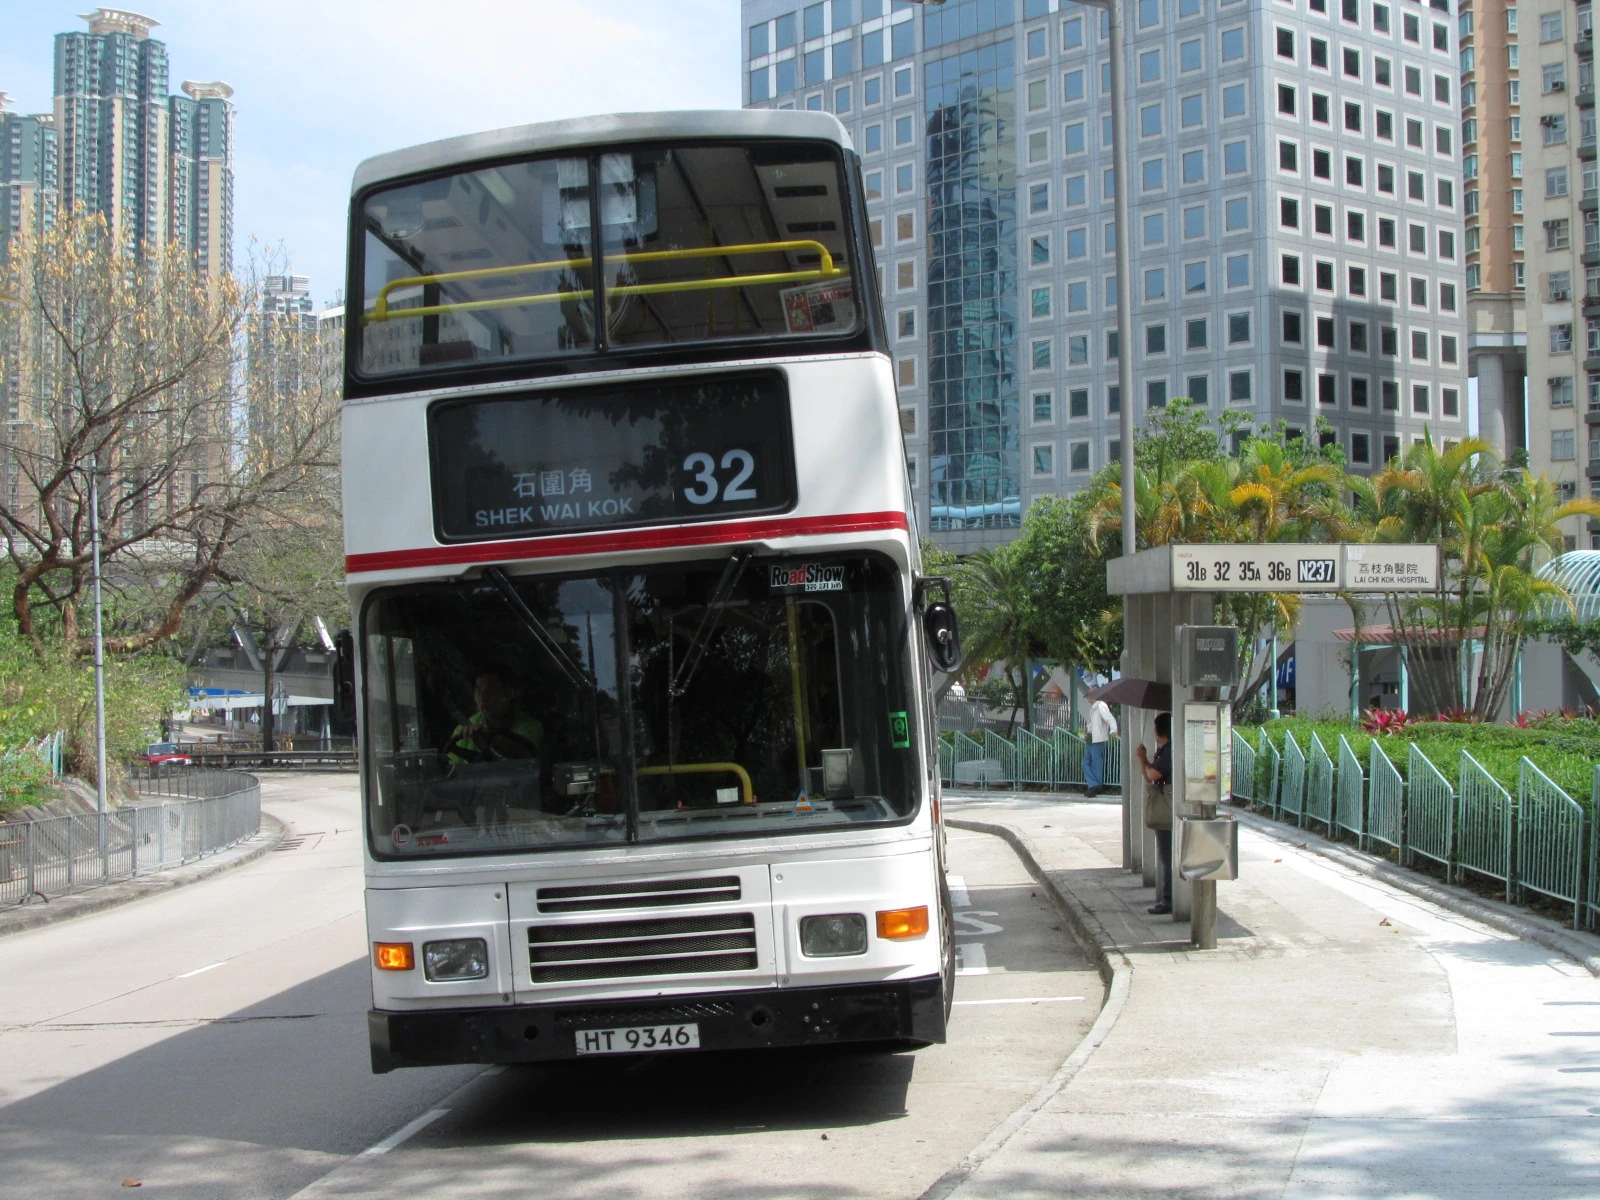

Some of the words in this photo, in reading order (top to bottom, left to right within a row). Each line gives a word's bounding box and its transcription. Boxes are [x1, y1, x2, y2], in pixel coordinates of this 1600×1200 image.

[512, 467, 592, 498] 石圍角
[682, 448, 758, 505] 32
[475, 507, 534, 527] SHEK
[540, 501, 581, 523] WAI
[588, 497, 635, 518] KOK
[771, 563, 844, 587] RoadShow
[1186, 561, 1207, 582] 31B
[1213, 561, 1231, 582] 32
[1238, 561, 1261, 582] 35A
[1267, 561, 1292, 582] 36B
[1299, 560, 1334, 583] N237
[1354, 576, 1366, 584] LAI
[1368, 576, 1380, 584] CHI
[1381, 576, 1395, 584] KOK
[1397, 576, 1430, 584] HOSPITAL
[584, 1030, 616, 1051] HT
[625, 1026, 691, 1049] 9346
